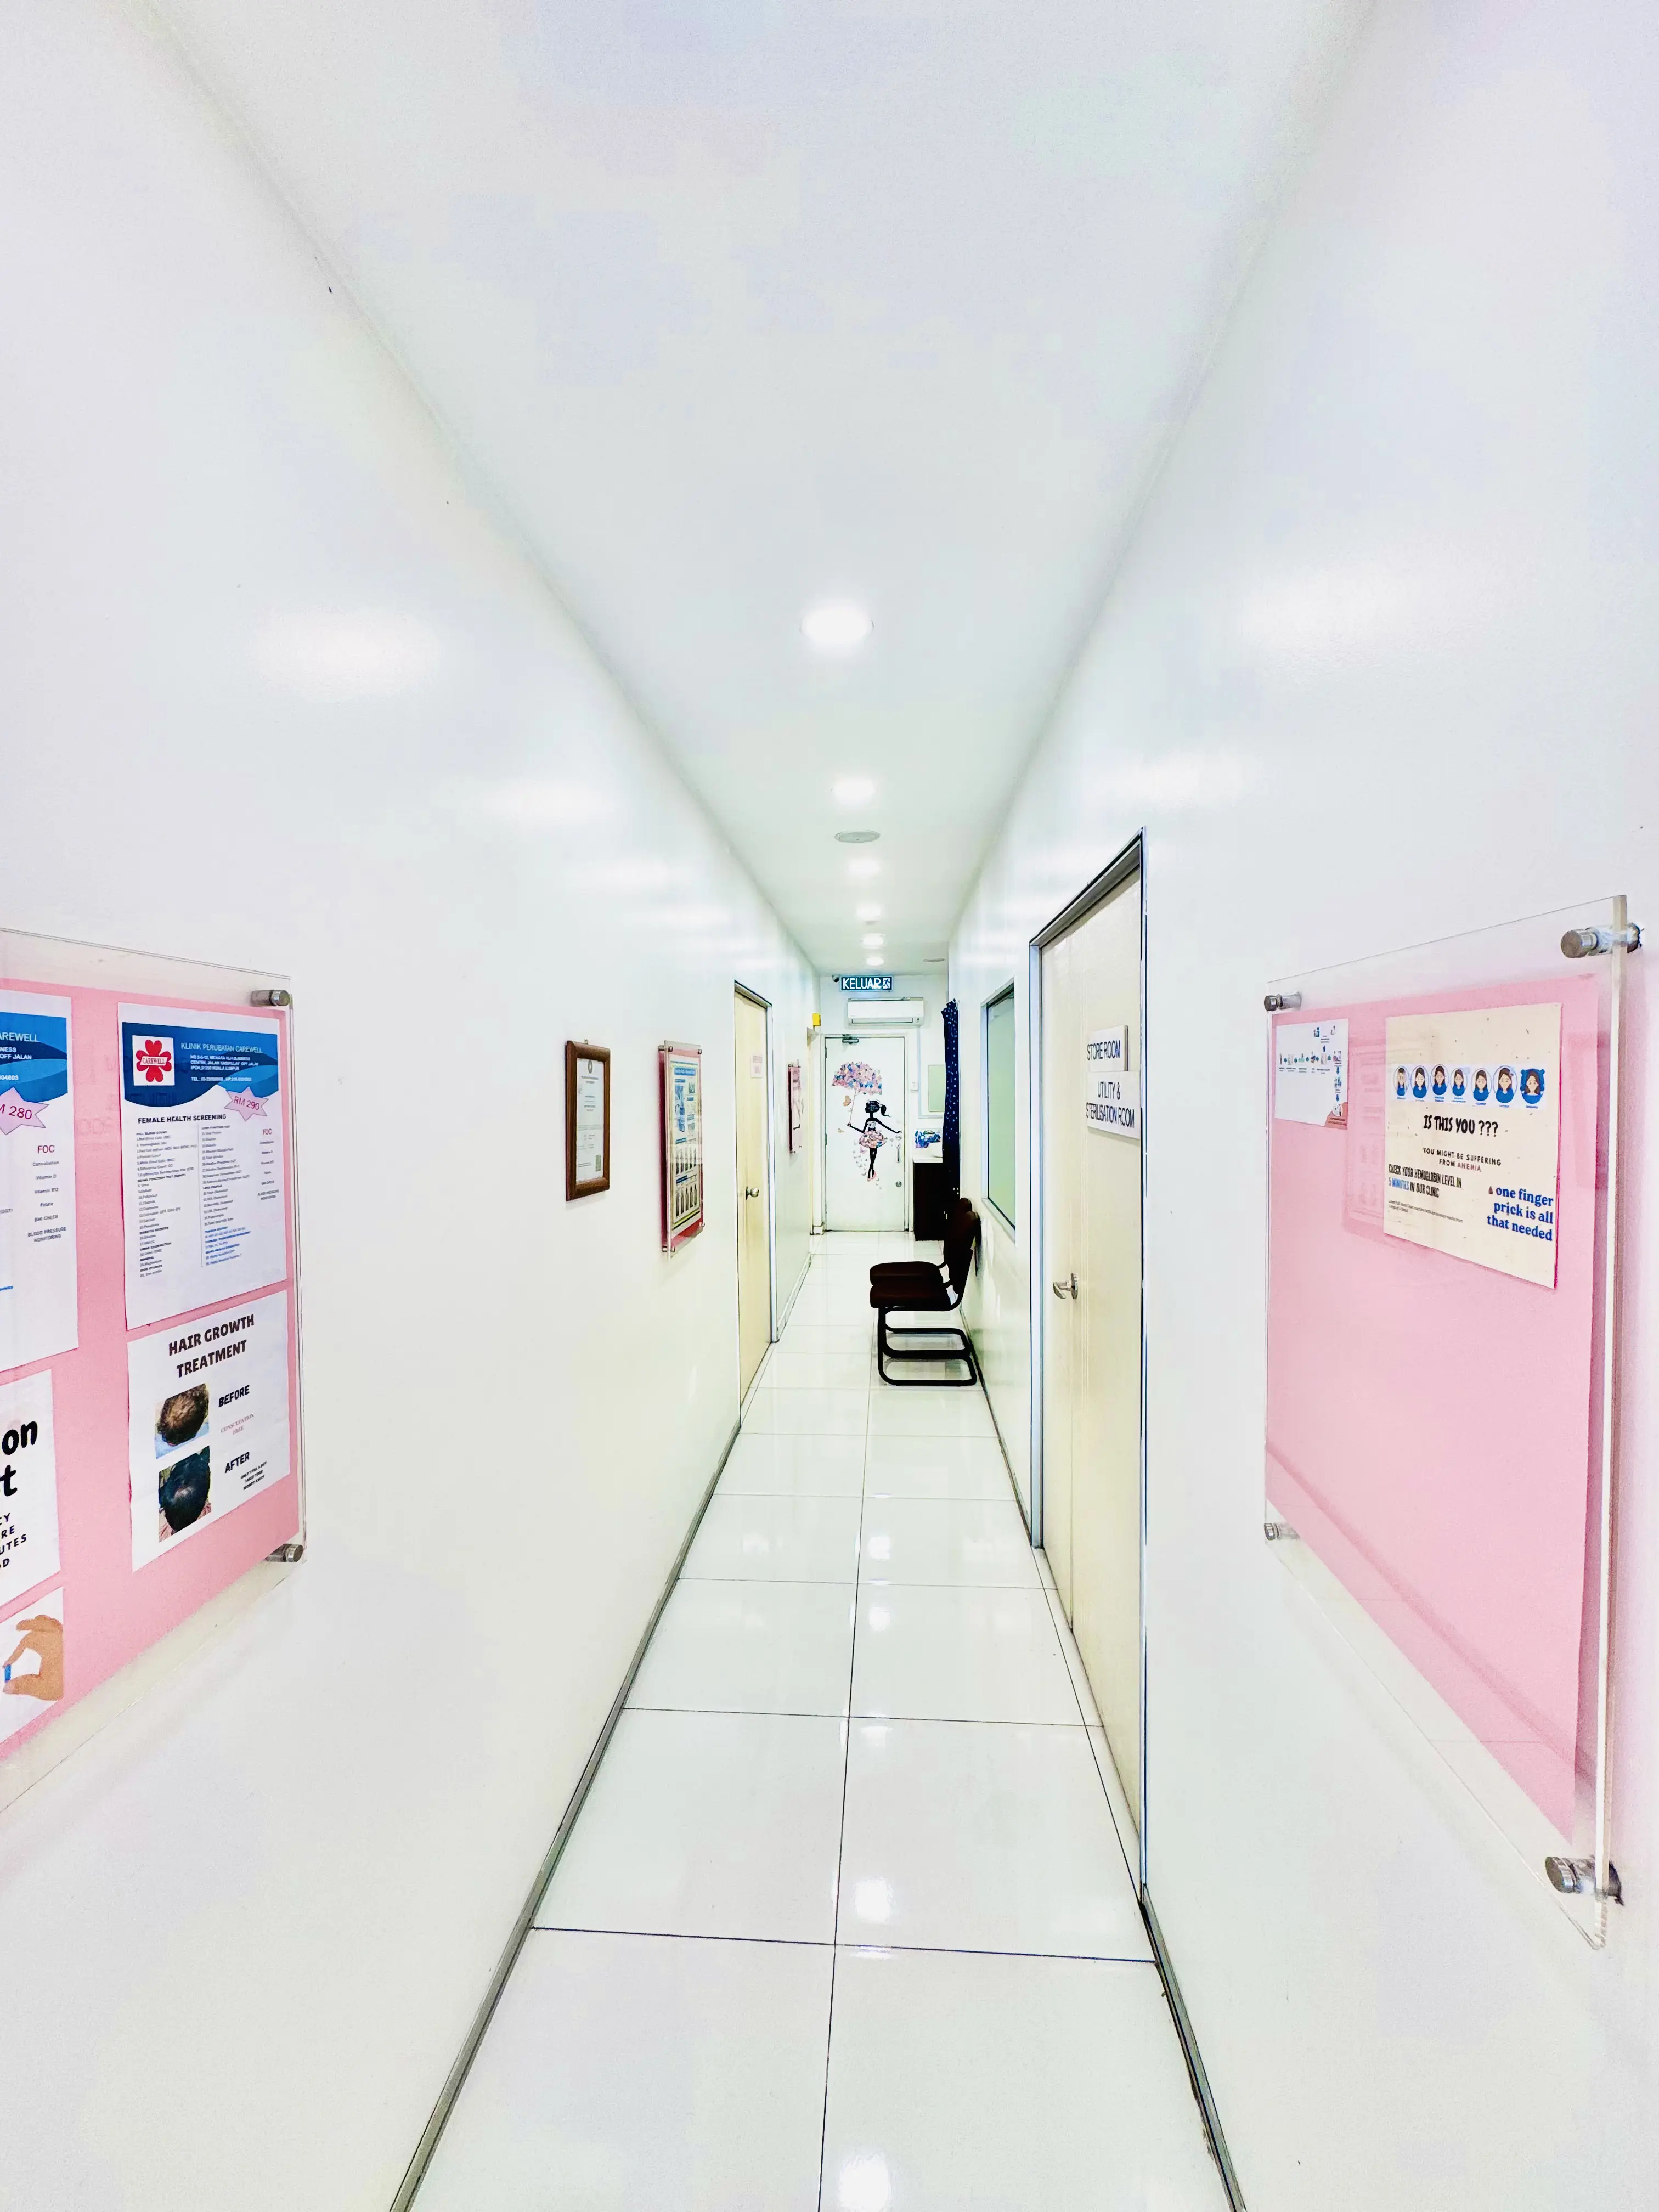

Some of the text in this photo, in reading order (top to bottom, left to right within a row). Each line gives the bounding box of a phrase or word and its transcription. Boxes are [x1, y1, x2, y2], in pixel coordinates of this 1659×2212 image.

[843, 978, 882, 989] KELUAR
[202, 1043, 235, 1052] PERUBATAN
[235, 1045, 263, 1053] CAREWELL
[1087, 1040, 1121, 1060] STORE ROOM
[1097, 1080, 1120, 1100] UTILITY &
[9, 1105, 32, 1120] 280
[234, 1096, 260, 1111] RM 290
[1086, 1102, 1135, 1128] STERILISATION ROOM
[1423, 1115, 1499, 1137] IS THIS YOU ???
[37, 1144, 55, 1154] FOC
[1423, 1147, 1435, 1155] YOU
[1436, 1149, 1454, 1159] MIGHT
[1466, 1154, 1502, 1166] SUFFERING
[1439, 1159, 1482, 1172] FROM ANEMIA
[1389, 1164, 1462, 1188] CHECK YOUR HEMOGLOBIN LEVEL IN
[1389, 1177, 1440, 1198] 5 MINUTES IN OUR CLINIC
[1496, 1187, 1554, 1207] one finger
[1494, 1201, 1553, 1224] prick is all
[1487, 1215, 1553, 1242] that needed
[168, 1314, 255, 1356] HAIR GROWTH
[177, 1339, 247, 1378] TREATMENT
[218, 1385, 250, 1408] BEFORE
[221, 1413, 255, 1433] CONSULTATION
[233, 1425, 244, 1435] FREE
[2, 1420, 38, 1455] on
[225, 1452, 250, 1474] AFTER
